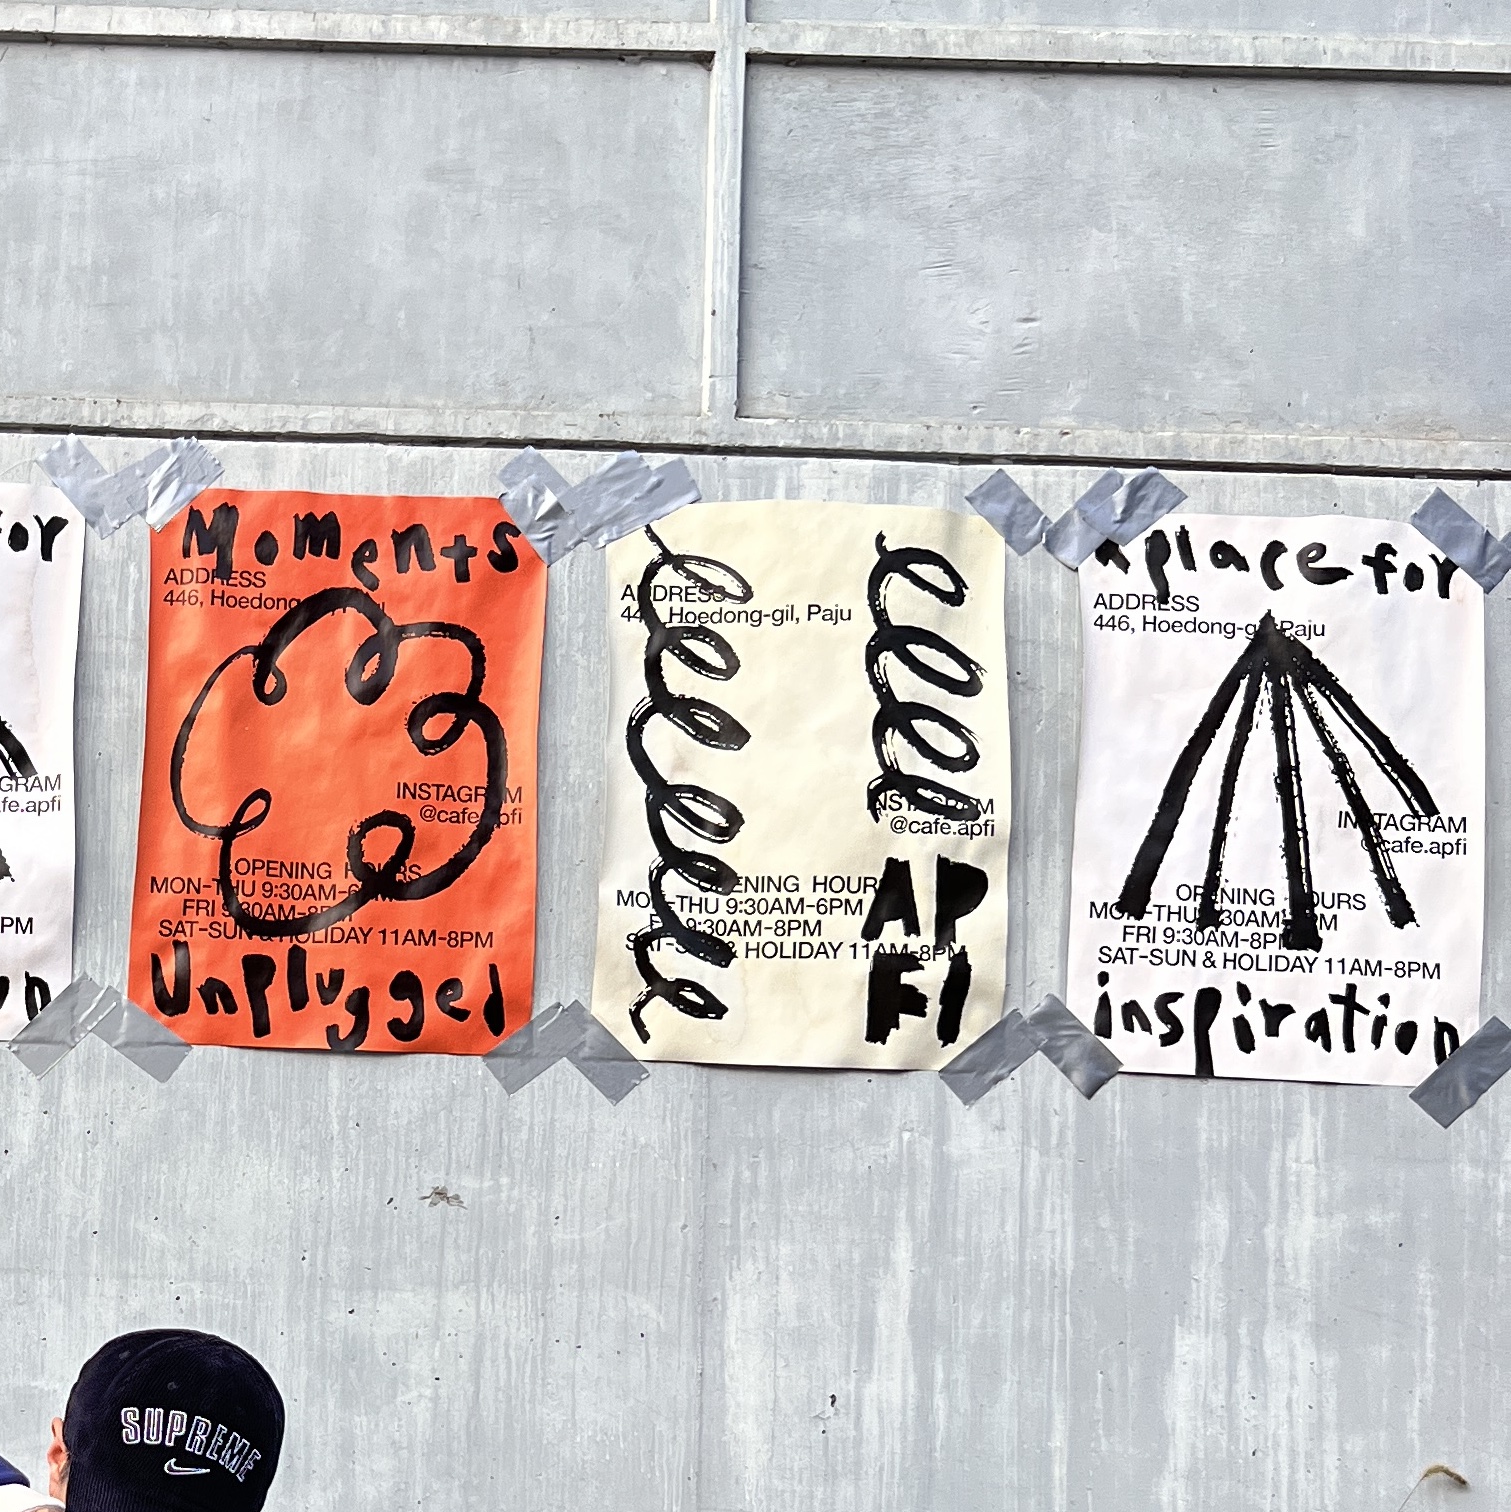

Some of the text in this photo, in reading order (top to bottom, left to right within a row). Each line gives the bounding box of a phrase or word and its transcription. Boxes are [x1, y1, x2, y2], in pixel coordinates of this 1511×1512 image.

[182, 502, 522, 592] Moments
[1145, 525, 1354, 605] place
[1361, 542, 1459, 599] for
[163, 588, 204, 609] 446,
[620, 584, 725, 603] ADRES
[620, 604, 852, 628] 44 Hoedong-gil, Paju
[1093, 614, 1326, 641] 446, Hoedong-g Paju
[396, 782, 523, 804] INSTAGRM
[420, 804, 523, 826] @cafefi
[1337, 811, 1467, 833] INTAGRAM
[890, 815, 995, 840] @cafe.apfi
[234, 858, 333, 880] OPENING
[261, 881, 386, 902] 9:30AM-6
[716, 875, 880, 895] ENING HOUR
[182, 899, 216, 917] FRI
[616, 889, 863, 916] MO-THU 9:30AM-6PM
[861, 854, 989, 948] AP
[1176, 884, 1367, 911] OPNING URS
[1089, 901, 1338, 932] MO-THU 30AMM
[378, 928, 494, 949] 11AM-8PM
[1122, 925, 1157, 944] FRI
[745, 941, 844, 960] HOLIDAY
[1098, 945, 1441, 980] SAT-SUN & HOLIDAY 11AM-8PM
[865, 951, 972, 1048] FI
[1093, 970, 1460, 1077] inspiration
[121, 1406, 262, 1484] SUPREME
